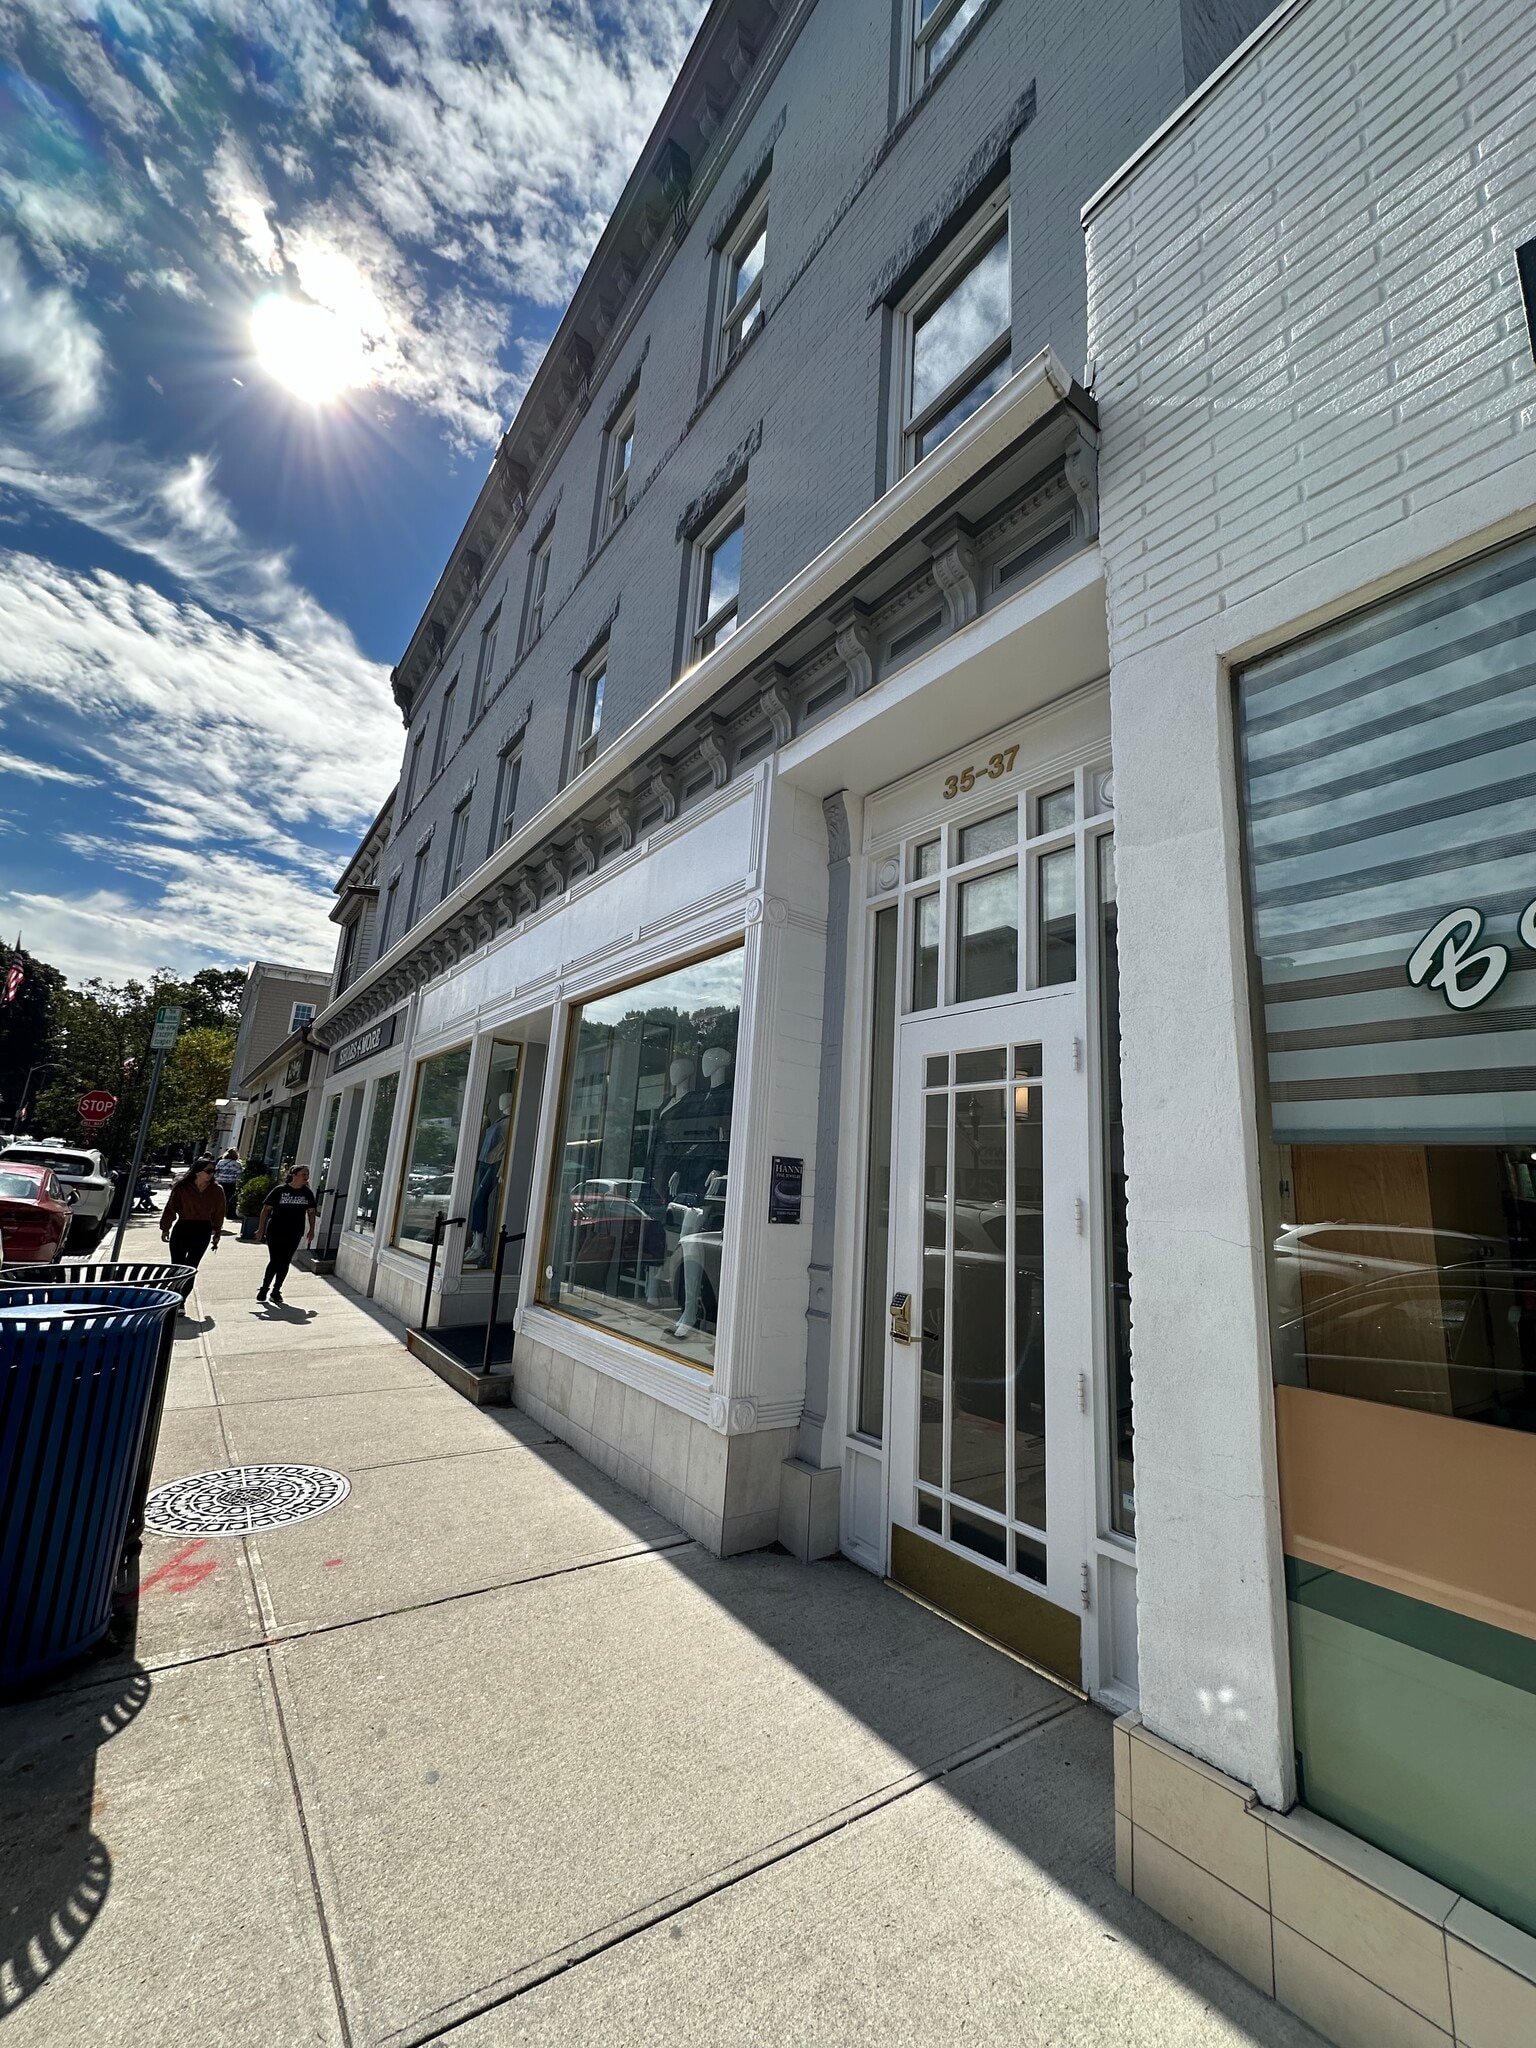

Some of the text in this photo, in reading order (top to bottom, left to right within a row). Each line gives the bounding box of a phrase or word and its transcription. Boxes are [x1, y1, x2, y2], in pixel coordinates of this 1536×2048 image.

[942, 743, 1020, 800] 35-37
[1406, 895, 1536, 1013] B
[360, 1027, 382, 1055] MORE
[81, 1099, 114, 1113] STOP
